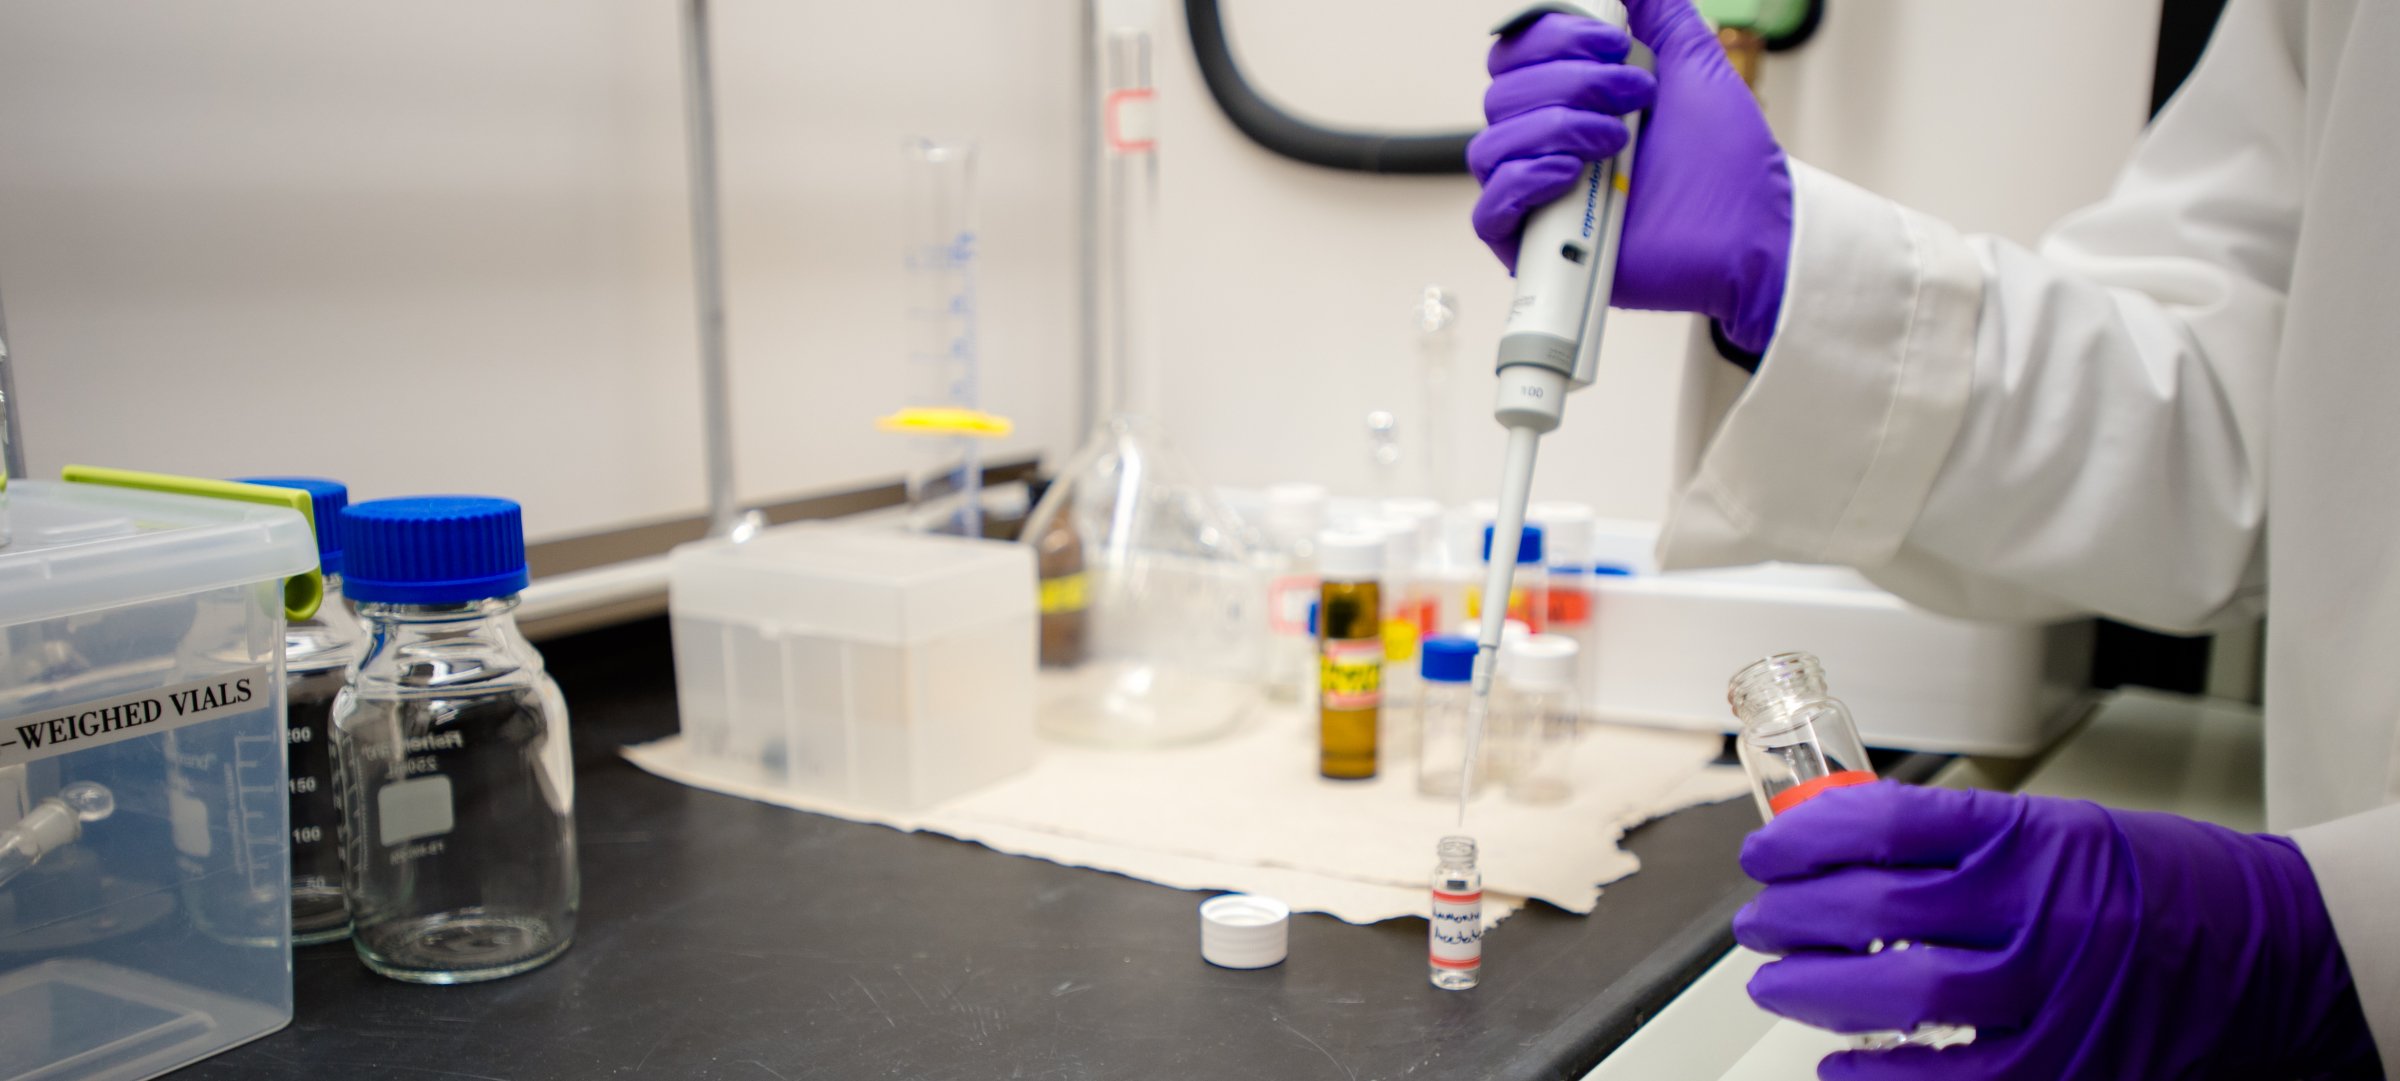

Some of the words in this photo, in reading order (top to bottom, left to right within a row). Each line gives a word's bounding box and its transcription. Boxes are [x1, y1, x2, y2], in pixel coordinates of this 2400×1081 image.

[1521, 384, 1544, 399] 100
[169, 678, 252, 717] VIALS
[289, 776, 316, 794] 150
[293, 826, 321, 844] 100
